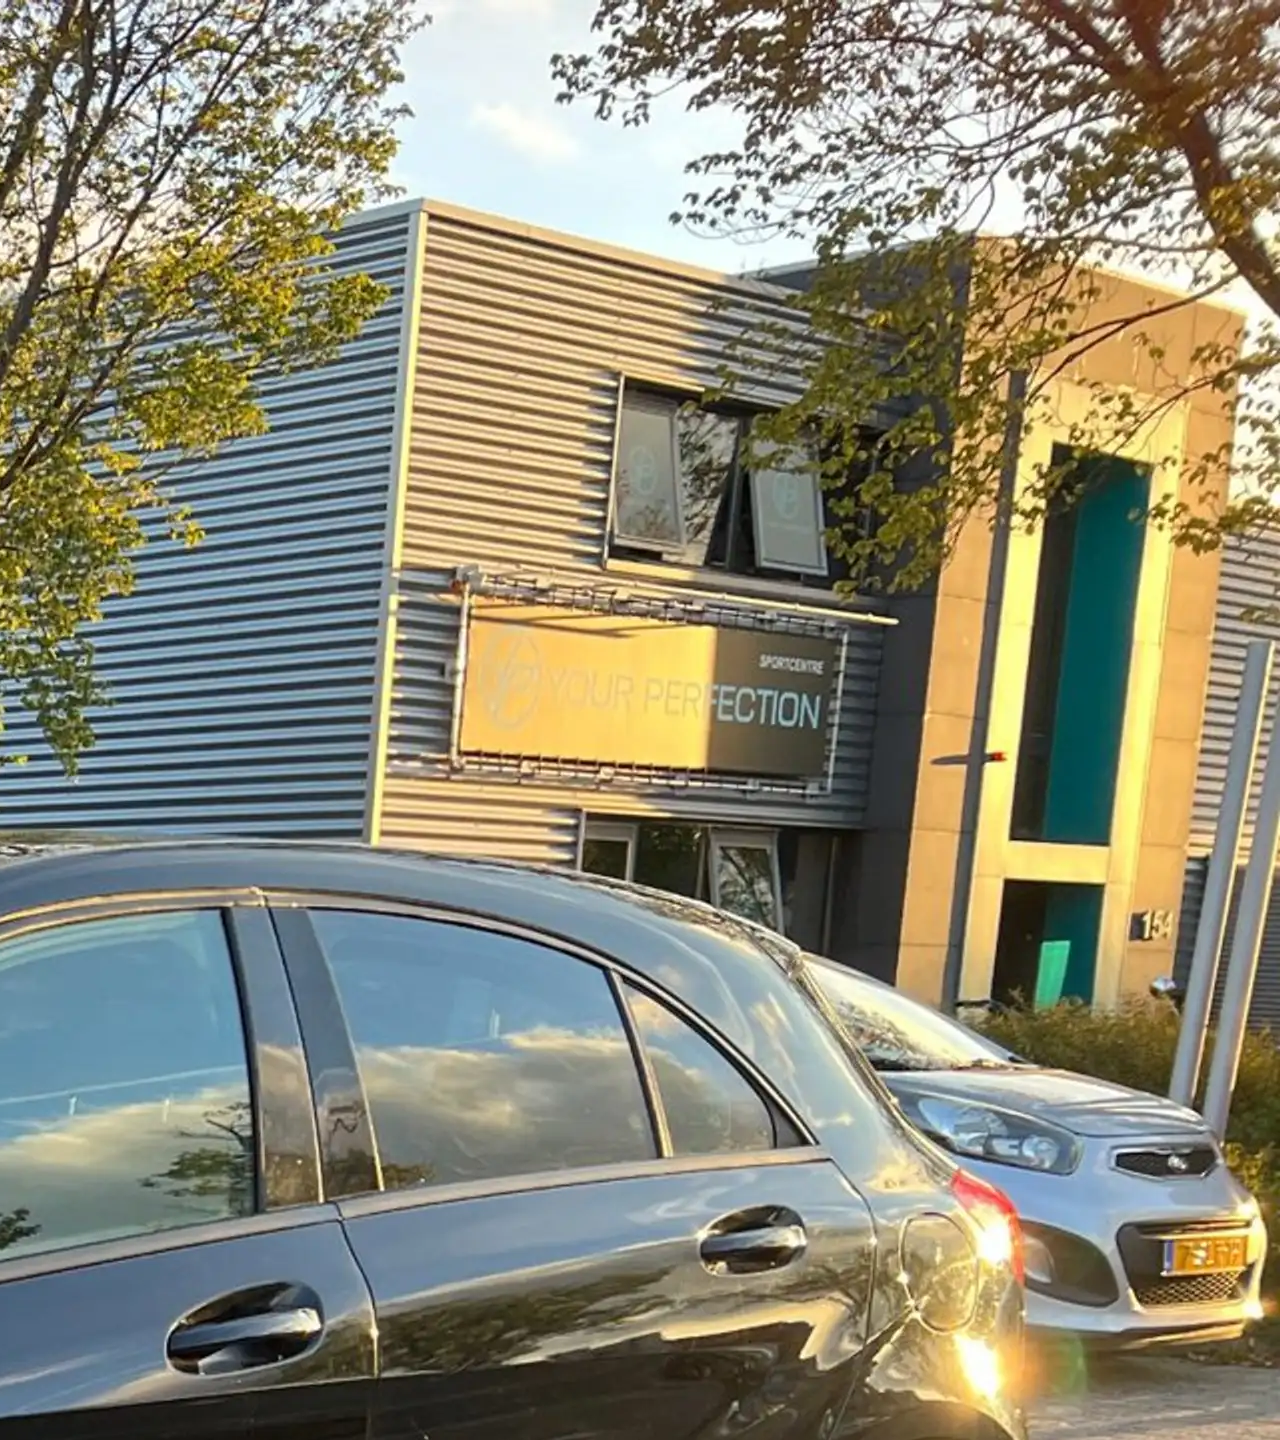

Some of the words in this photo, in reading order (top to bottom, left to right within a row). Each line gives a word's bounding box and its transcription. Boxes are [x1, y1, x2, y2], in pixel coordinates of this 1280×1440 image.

[758, 653, 824, 675] SPORTCENTRE
[547, 666, 634, 713] YOUR
[643, 677, 822, 730] PERFECTION
